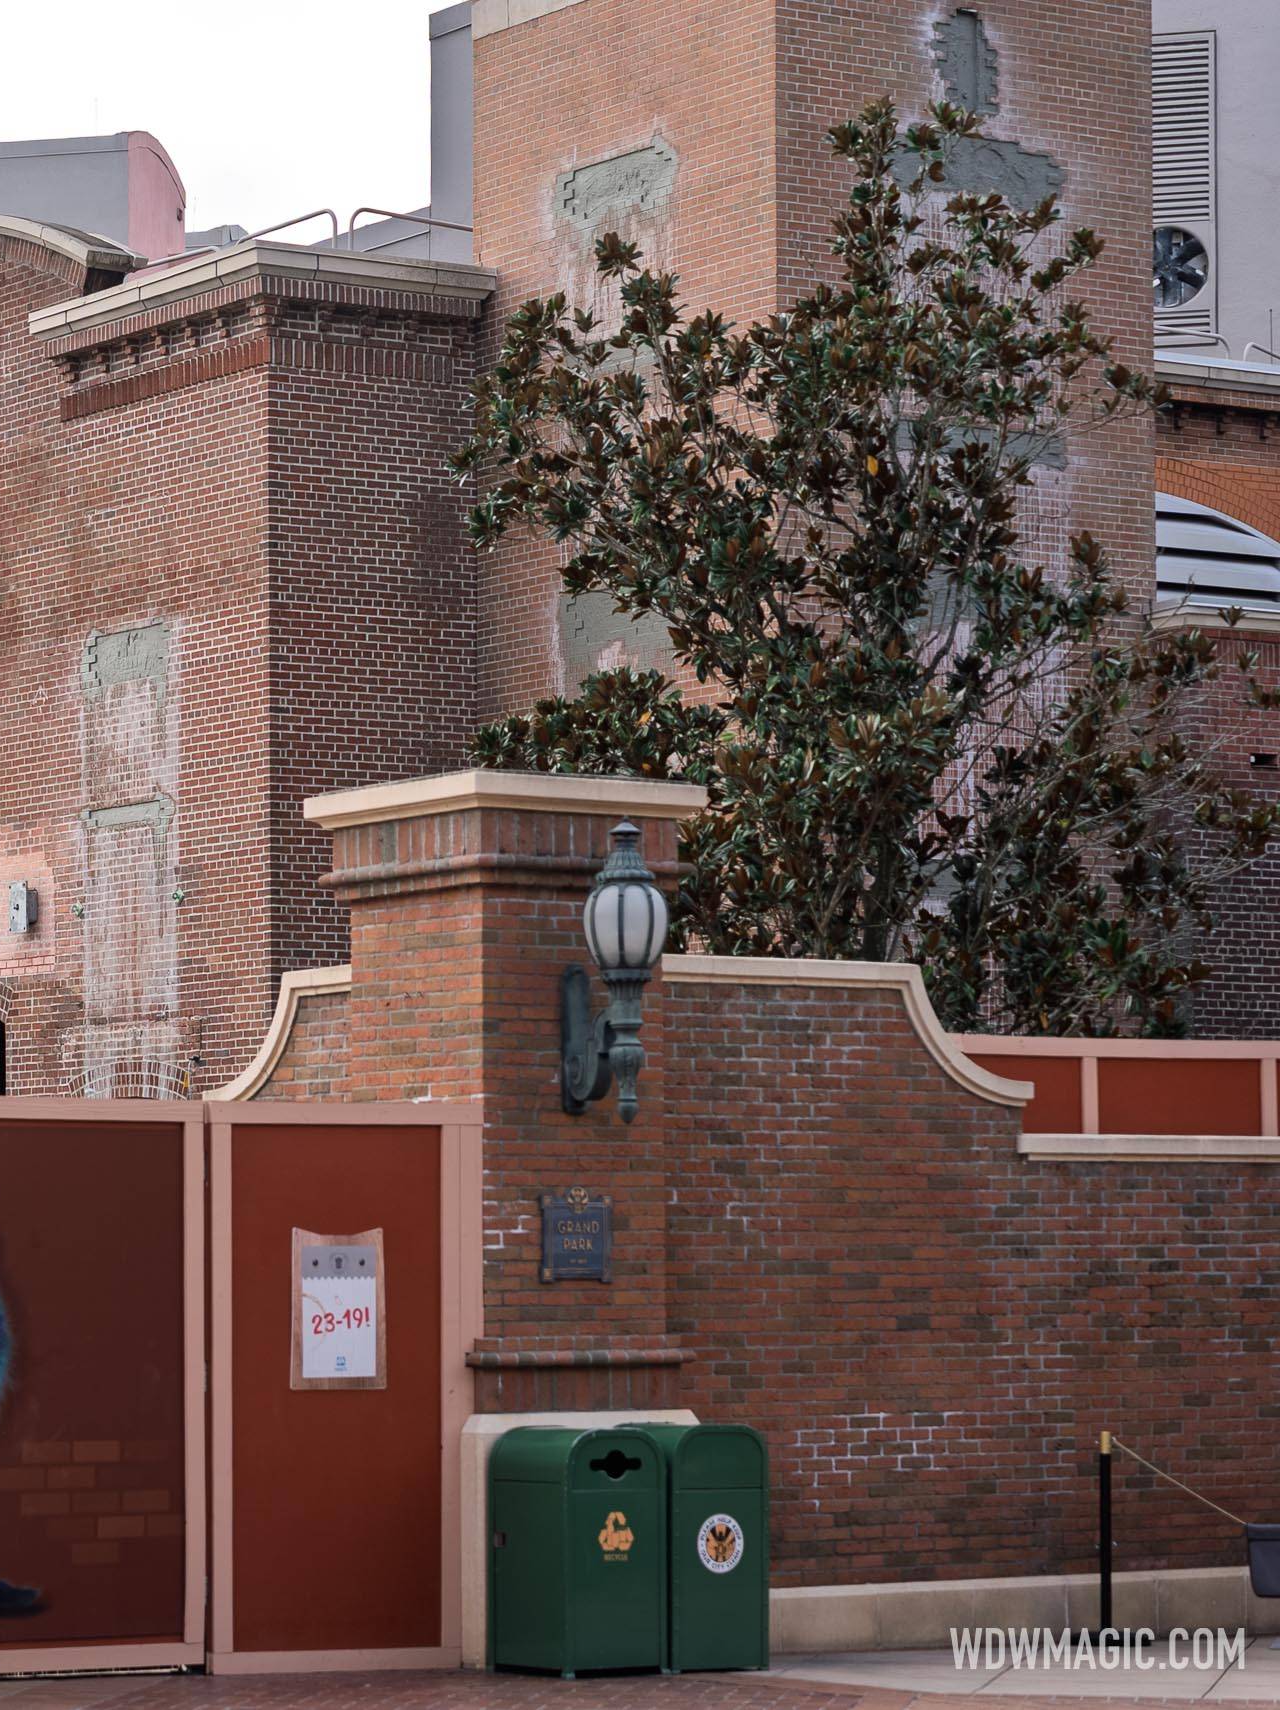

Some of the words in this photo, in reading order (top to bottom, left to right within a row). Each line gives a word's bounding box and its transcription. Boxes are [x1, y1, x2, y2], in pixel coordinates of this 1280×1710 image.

[557, 1220, 600, 1234] GRAND
[563, 1238, 593, 1251] PARK
[311, 1306, 370, 1335] 23-19!
